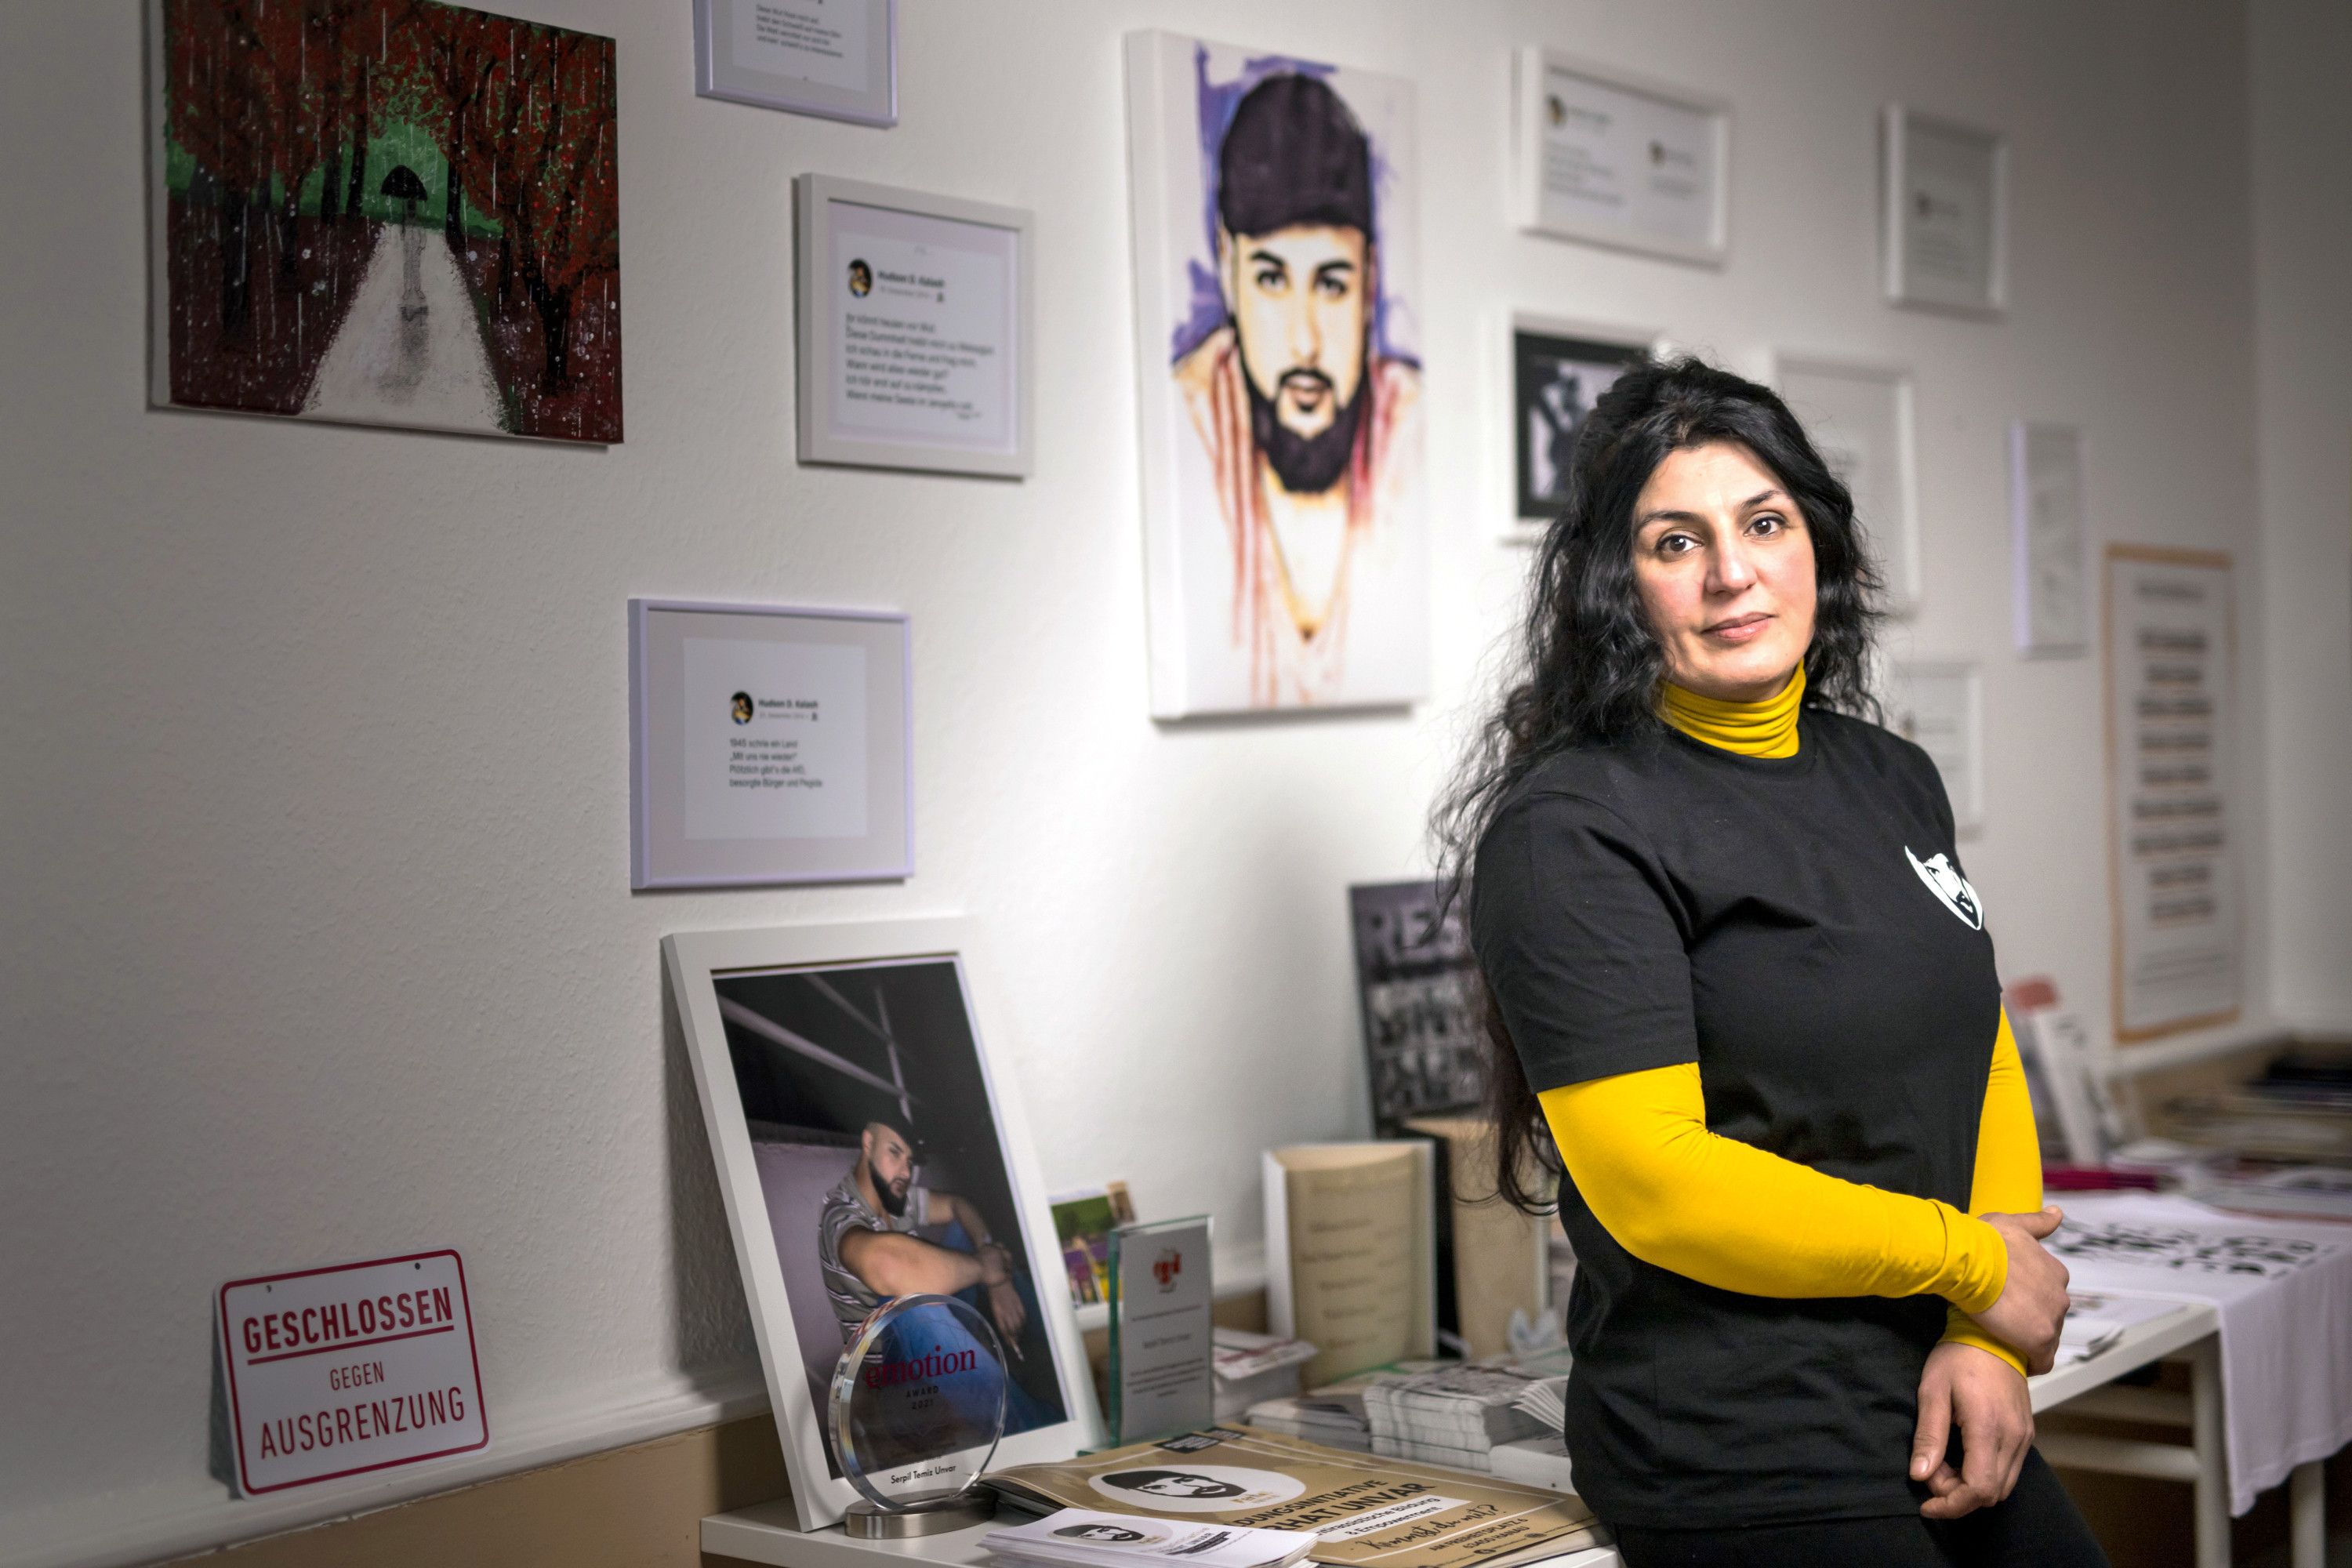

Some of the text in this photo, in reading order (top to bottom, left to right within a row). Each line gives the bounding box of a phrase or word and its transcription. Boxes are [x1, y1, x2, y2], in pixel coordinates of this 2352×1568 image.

[243, 1286, 453, 1353] GESCHLOSSEN
[329, 1361, 385, 1391] GEGEN
[866, 1345, 977, 1388] emotion
[906, 1385, 939, 1398] AWARD
[912, 1399, 934, 1410] 2021
[260, 1386, 465, 1460] AUSGRENZUNG
[891, 1465, 956, 1484] Serpil Temiz Unvar
[1224, 1479, 1388, 1526] LDUNGSINITIATIVE
[1260, 1483, 1436, 1530] RHAT UNVAR
[1316, 1497, 1441, 1536] ntirassistische Bildung
[1354, 1506, 1443, 1533] Empowerment
